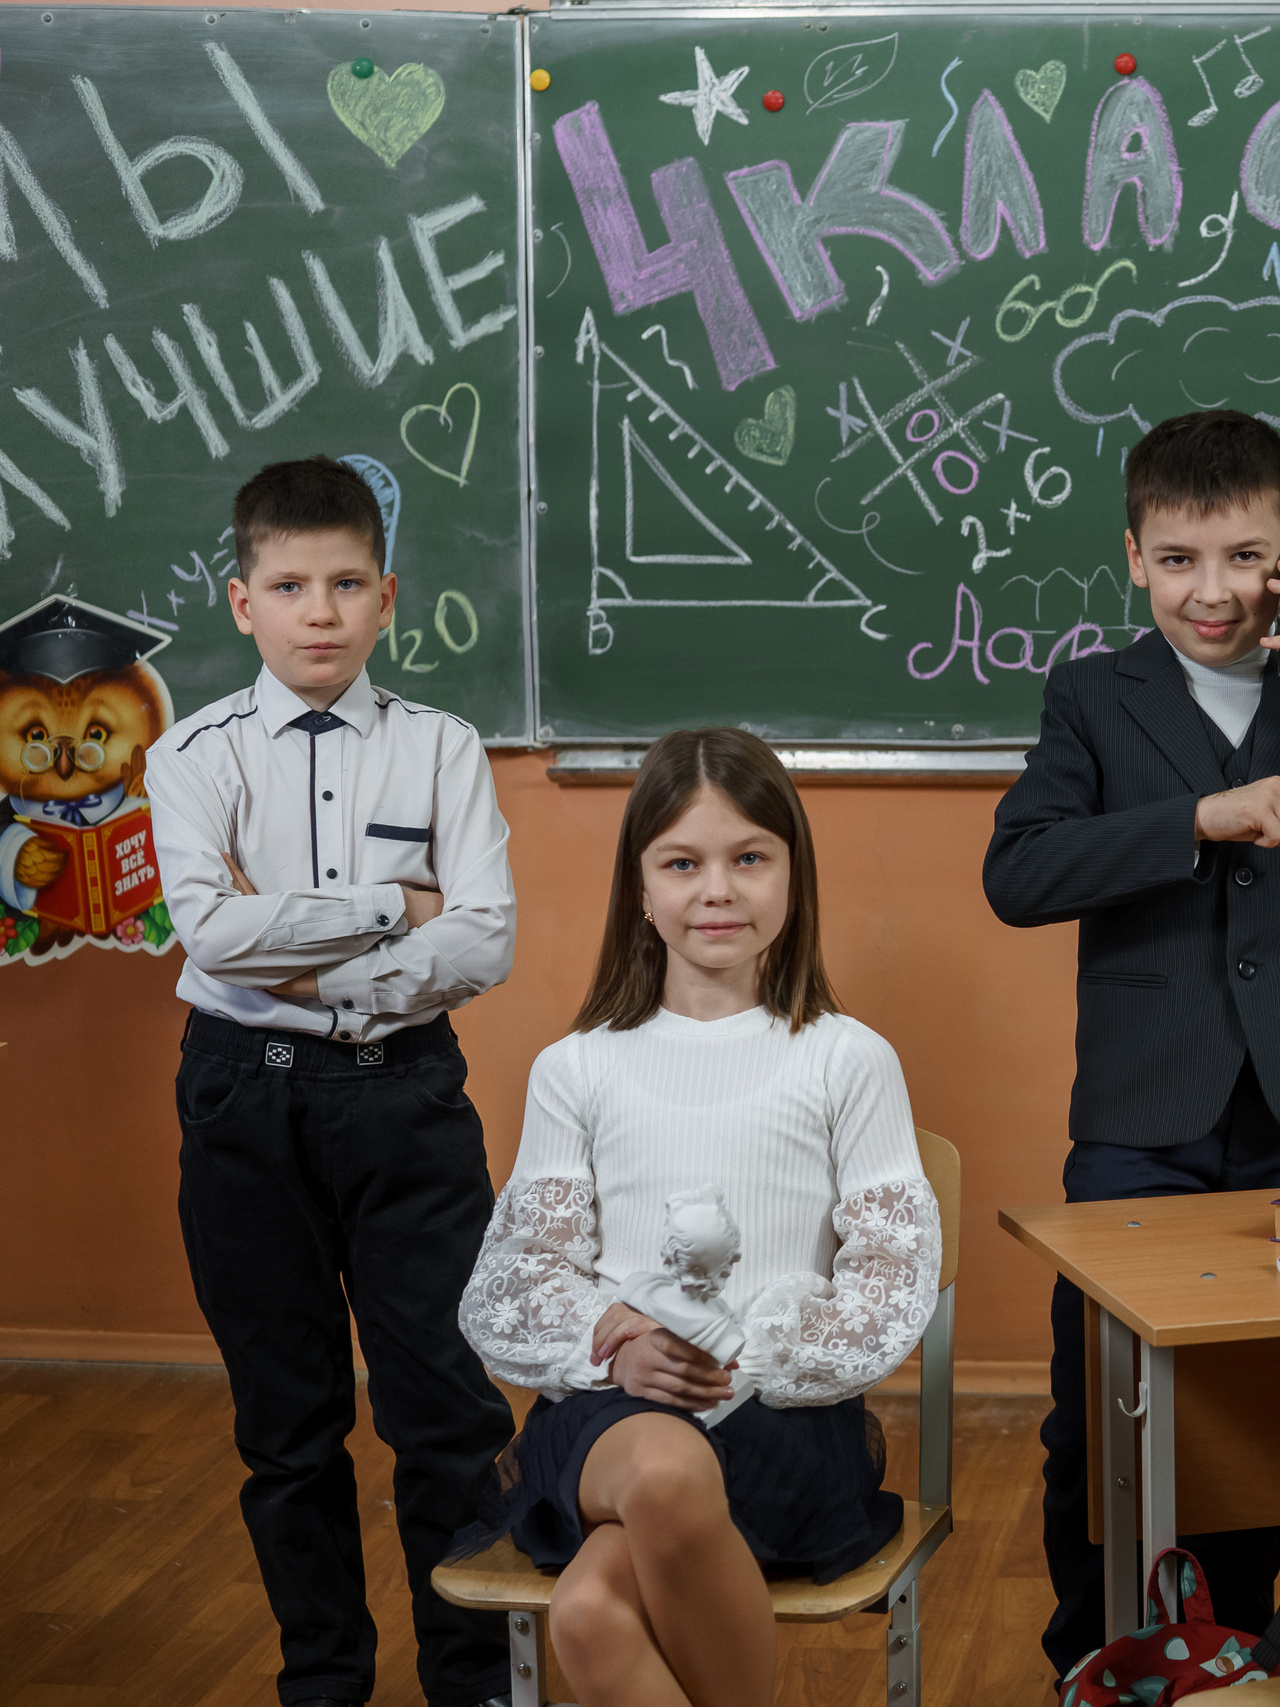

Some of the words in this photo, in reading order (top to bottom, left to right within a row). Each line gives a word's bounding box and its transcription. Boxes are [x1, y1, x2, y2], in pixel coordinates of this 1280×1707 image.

[553, 101, 777, 392] 4
[114, 829, 147, 859] ХОЧУ
[114, 864, 155, 897] ЗНАТЬ
